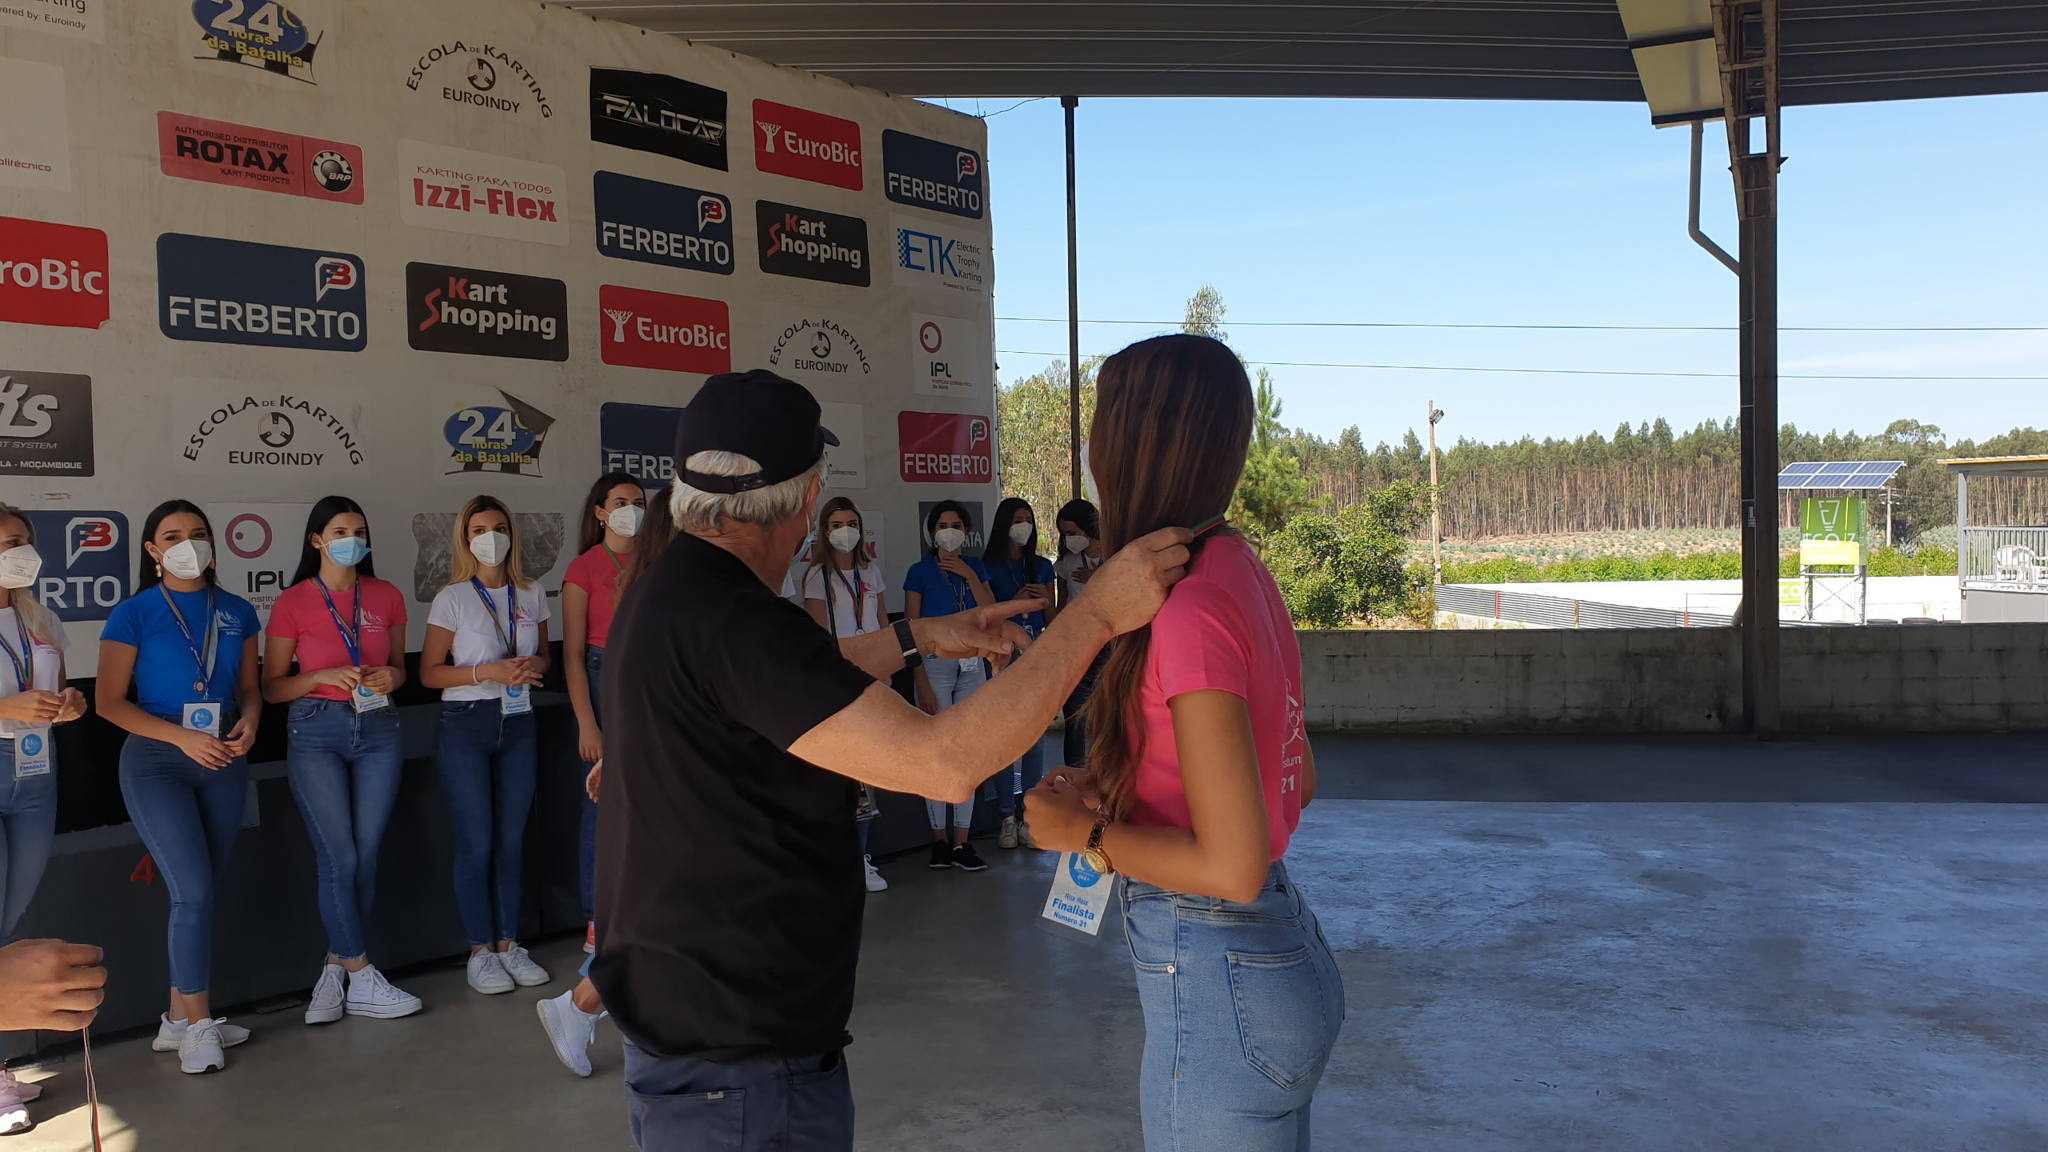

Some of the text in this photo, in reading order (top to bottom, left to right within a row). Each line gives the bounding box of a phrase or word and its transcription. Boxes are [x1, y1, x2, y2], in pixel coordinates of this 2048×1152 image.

[0, 7, 24, 17] ered
[44, 14, 86, 31] Euroindy
[210, 0, 284, 43] 24
[227, 26, 273, 46] horas
[207, 36, 304, 68] da Batalha
[406, 40, 553, 119] ESCOLA DE KARTING
[442, 87, 520, 114] EUROINDY
[175, 125, 289, 151] AUTHORISED DISTRIBUTOR
[784, 131, 860, 167] EuroBic
[176, 135, 289, 174] ROTAX
[220, 167, 291, 185] KART PRODUCTS
[328, 172, 352, 182] BRP
[417, 165, 552, 194] KARTING PARA TODOS
[413, 177, 557, 223] Izzi-Flex
[888, 172, 980, 212] FERBERTO
[785, 213, 826, 238] Kart
[602, 221, 730, 265] FERBERTO
[767, 222, 861, 269] Shopping
[902, 229, 958, 277] ETK
[956, 241, 981, 255] Electric
[957, 255, 980, 270] Trophy
[448, 276, 508, 305] Kart
[958, 270, 982, 284] Karting
[169, 296, 360, 341] FERBERTO
[419, 287, 557, 341] Shopping
[637, 317, 727, 350] EuroBic
[769, 319, 811, 366] ESCOLA
[821, 319, 871, 375] KARTING
[794, 359, 849, 374] EUROINDY
[931, 361, 952, 378] IPL
[183, 395, 260, 462] ESCOLA
[279, 394, 364, 466] KARTING
[457, 409, 516, 447] 24
[12, 441, 57, 450] SYSTEM
[228, 450, 325, 466] EUROINDY
[455, 451, 532, 465] da Batalha
[472, 438, 508, 451] horas
[20, 460, 82, 470] MOÇAMBIQUE
[904, 453, 990, 476] FERBERTO
[39, 576, 122, 608] RTO
[1281, 774, 1295, 794] 21
[130, 852, 156, 886] 4
[1052, 898, 1095, 921] Finalista
[1079, 919, 1087, 928] 21
